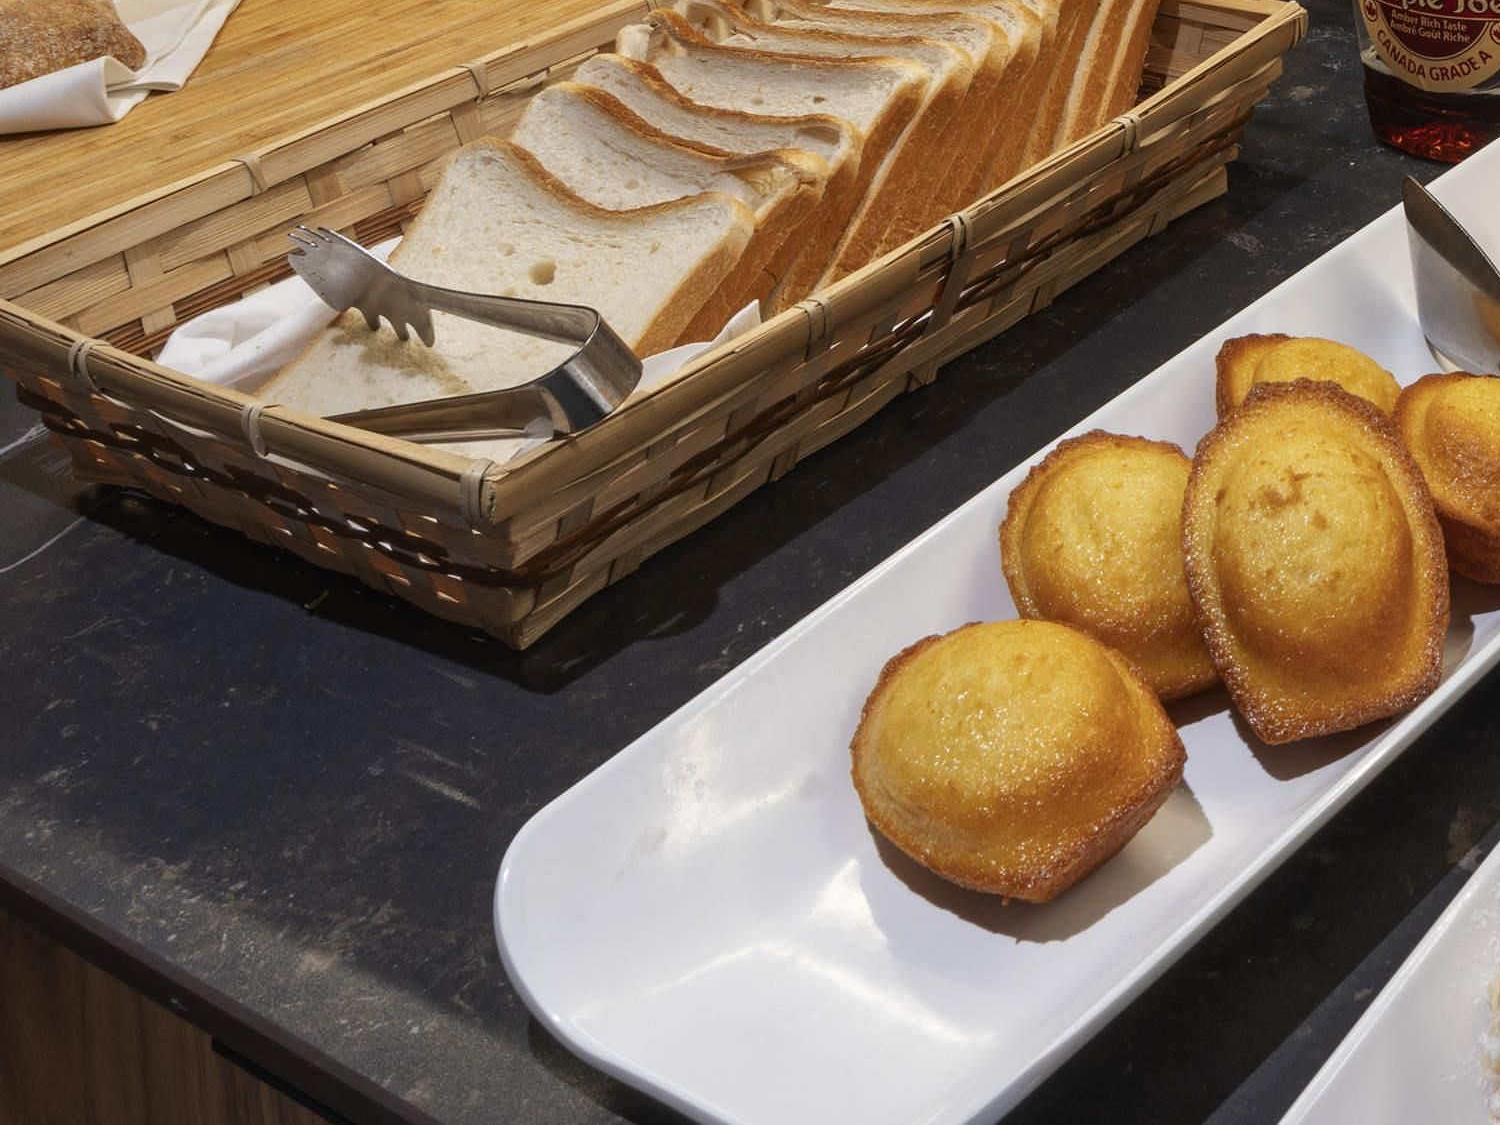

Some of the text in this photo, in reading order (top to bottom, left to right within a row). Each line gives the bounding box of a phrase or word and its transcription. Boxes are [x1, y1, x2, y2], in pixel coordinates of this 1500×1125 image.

[1389, 19, 1471, 43] Ambré Goût Riche
[1391, 9, 1468, 32] Amber Rich Taste
[1377, 29, 1493, 82] CANADA GRADE A
